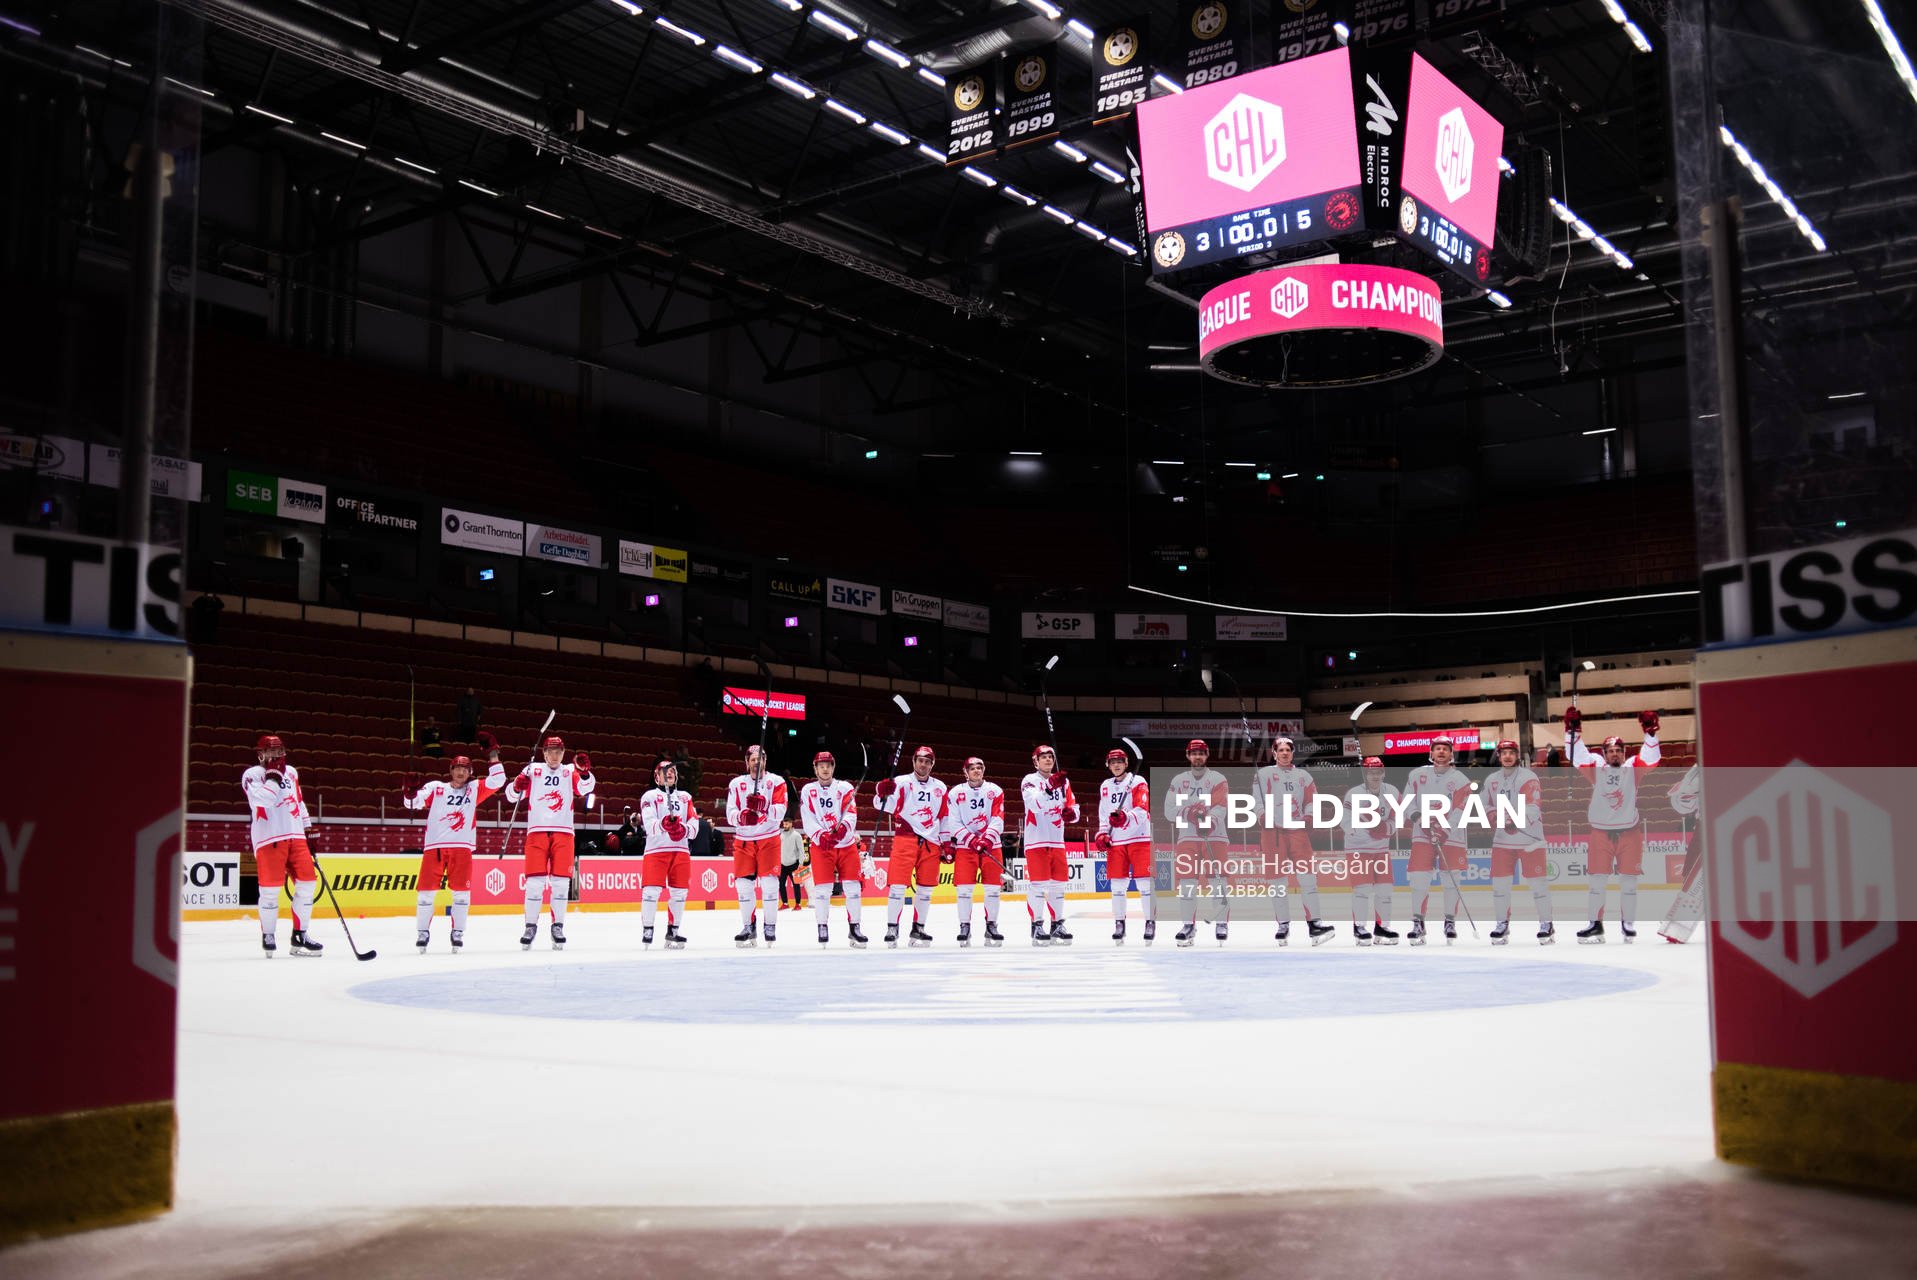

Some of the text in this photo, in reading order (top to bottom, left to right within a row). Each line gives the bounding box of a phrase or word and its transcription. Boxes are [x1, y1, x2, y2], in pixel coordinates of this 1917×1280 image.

[1188, 40, 1233, 57] SVENSKA
[1278, 35, 1331, 61] 1977
[1100, 66, 1143, 83] SVENSKA
[1185, 61, 1238, 87] 1980
[1011, 92, 1051, 109] SVENSKA
[1097, 87, 1147, 112] 1993
[951, 111, 989, 128] SVENSKA
[1008, 112, 1055, 137] 1999
[948, 130, 994, 155] 2012
[1213, 106, 1278, 178] CHL
[1440, 120, 1469, 187] CHL
[1366, 145, 1375, 184] Electro
[1380, 146, 1389, 208] MIDROC
[1196, 232, 1211, 251] 3
[1297, 209, 1313, 230] 5
[1421, 216, 1430, 236] 3
[1464, 245, 1473, 264] 5
[1273, 283, 1306, 317] CHL
[235, 482, 273, 502] SEB
[770, 579, 811, 596] CALL UP
[831, 585, 876, 607] SKF
[908, 594, 940, 610] Gruppen
[1052, 618, 1081, 631] GSP
[765, 699, 785, 709] OCKEY
[786, 702, 805, 711] LEAGUE
[1297, 743, 1338, 753] Lindholms
[1396, 735, 1479, 748] CHAMPIONS LEAGUE
[544, 775, 560, 786] 20
[447, 795, 464, 806] 22
[819, 797, 833, 808] 96
[918, 791, 931, 802] 21
[970, 799, 985, 810] 34
[1111, 792, 1123, 803] 87
[1647, 845, 1680, 853] TISSOT
[487, 871, 505, 893] CHL
[597, 873, 643, 890] HOCKEY
[1731, 789, 1882, 967] CHL
[212, 893, 238, 905] 1853
